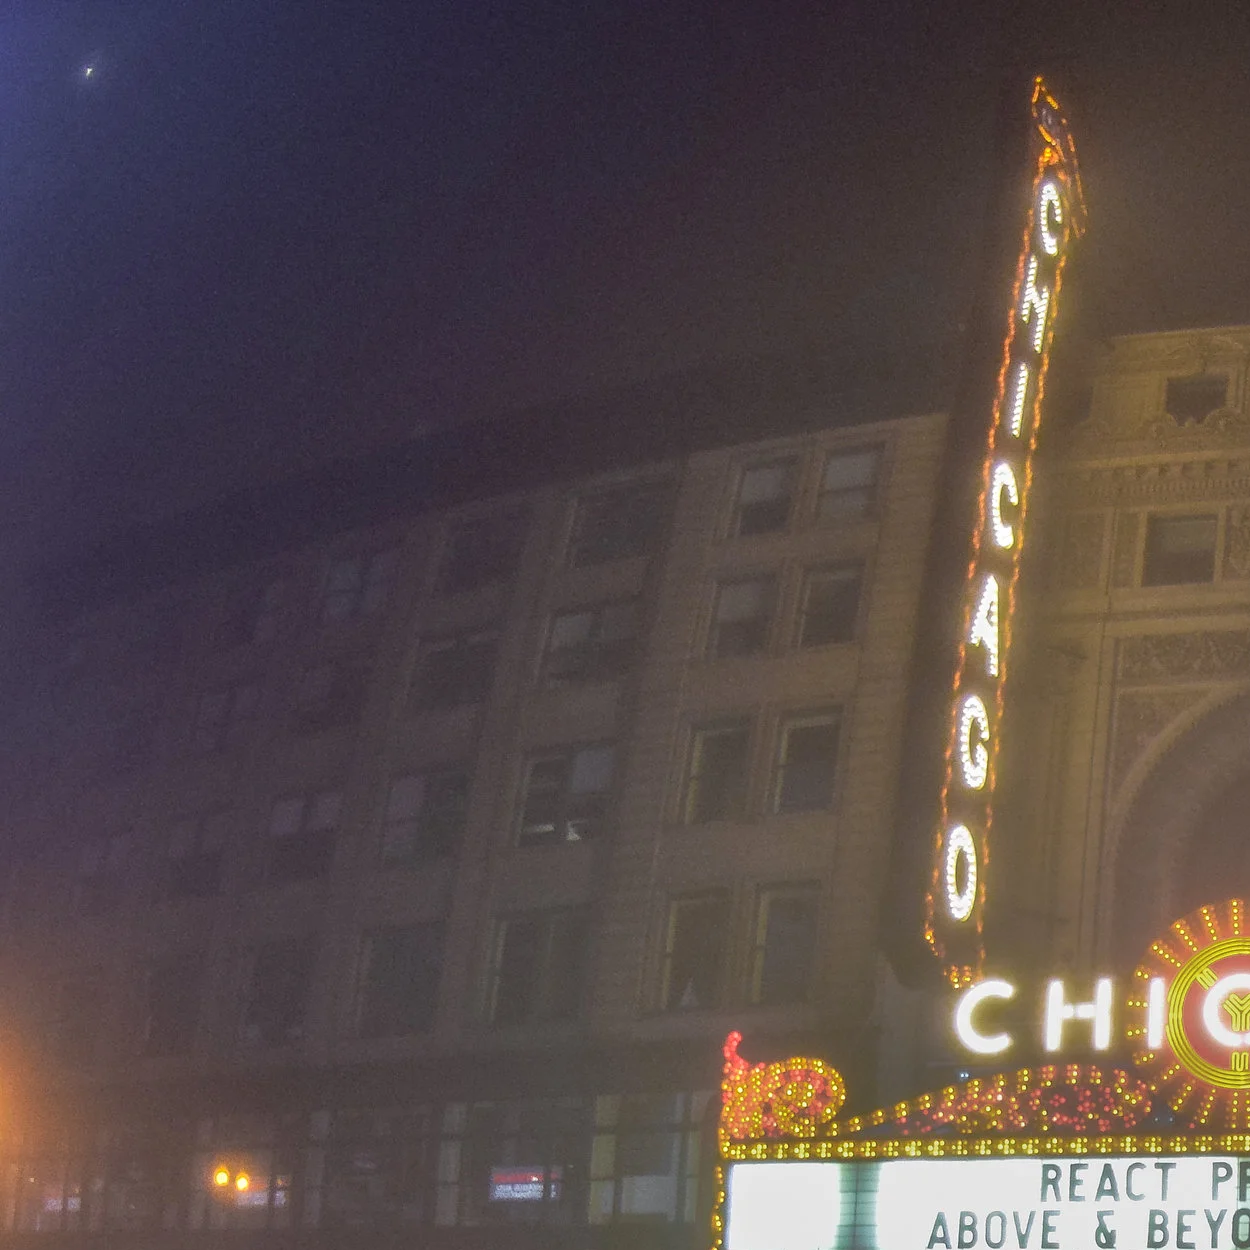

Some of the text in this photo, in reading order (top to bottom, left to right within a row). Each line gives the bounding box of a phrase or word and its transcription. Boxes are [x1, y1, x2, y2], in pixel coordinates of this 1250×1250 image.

[946, 180, 1063, 922] CHICAGO
[1040, 1161, 1177, 1203] REACT
[926, 1209, 1062, 1250] ABOVE
[1093, 1209, 1117, 1250] &
